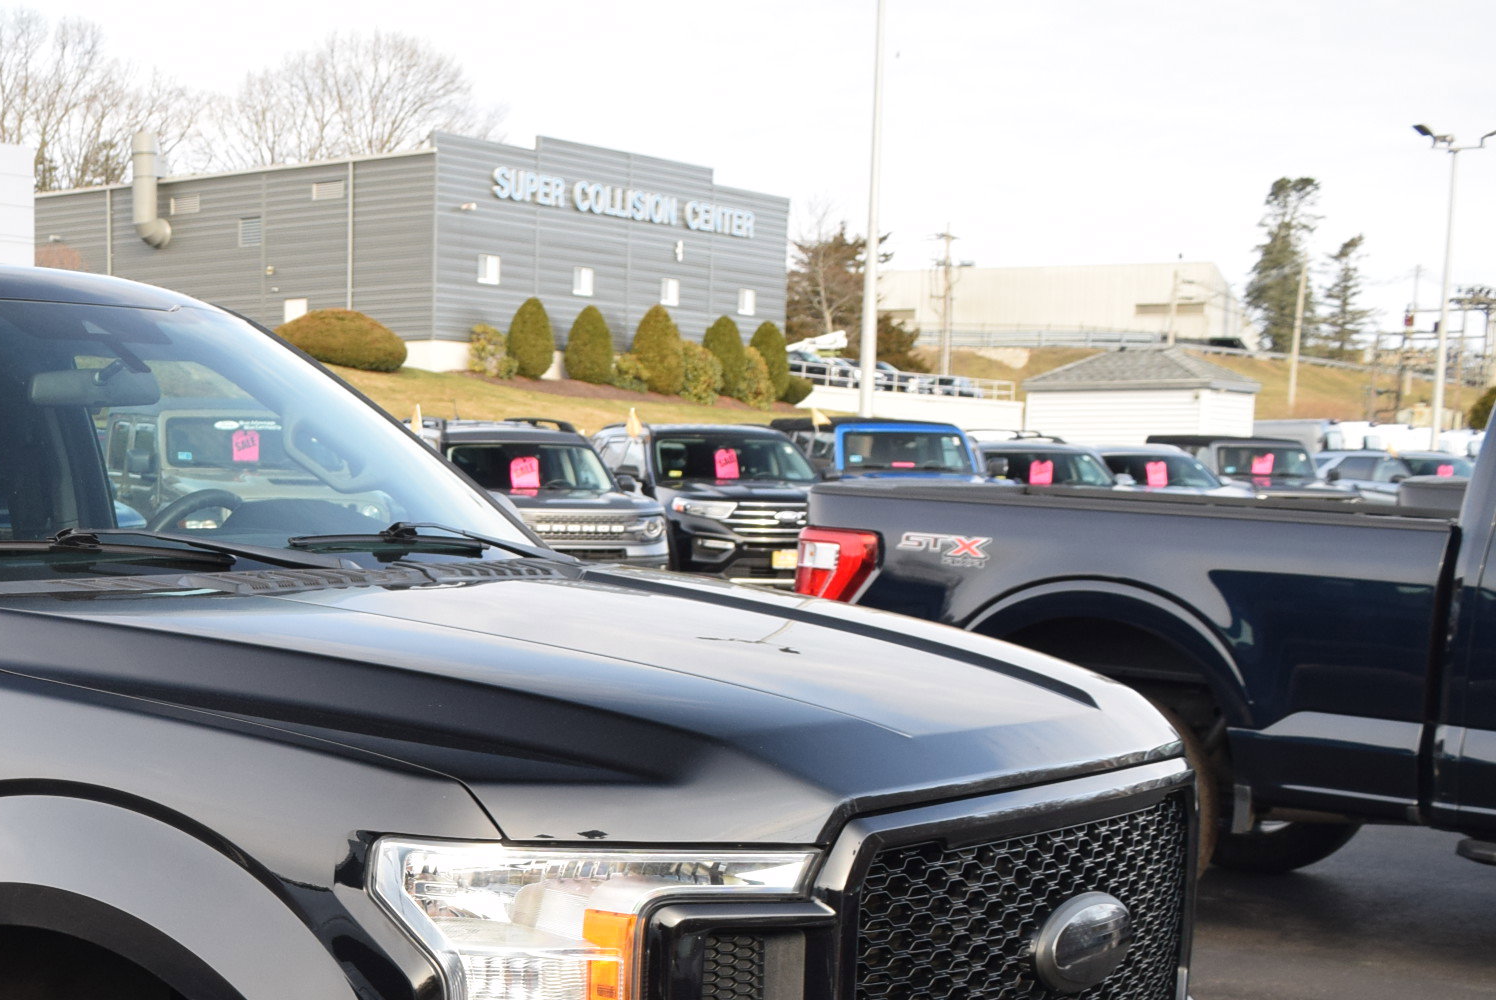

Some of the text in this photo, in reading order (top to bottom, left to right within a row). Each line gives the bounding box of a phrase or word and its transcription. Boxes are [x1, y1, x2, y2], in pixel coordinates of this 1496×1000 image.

[492, 166, 754, 239] SUPER COLLISION CENTER
[235, 437, 257, 451] SALE
[895, 531, 993, 559] STX
